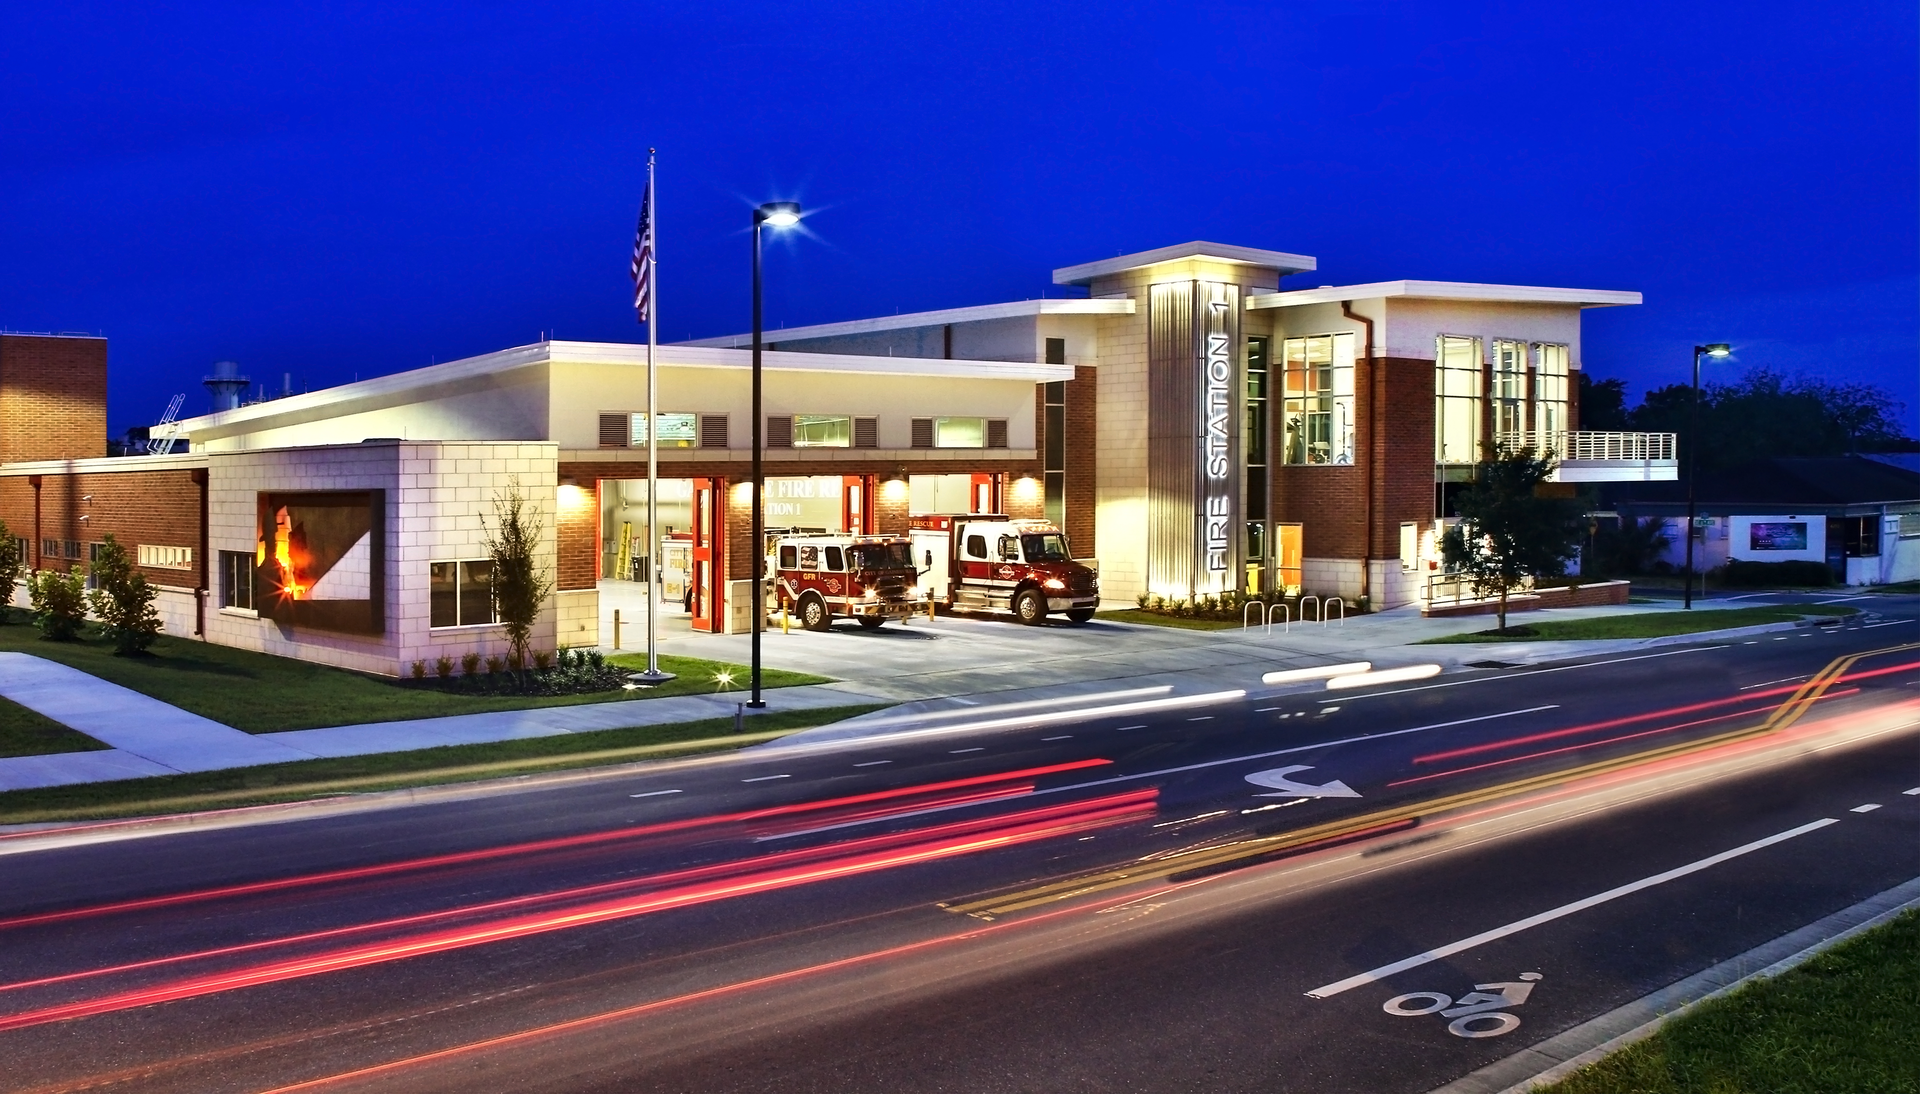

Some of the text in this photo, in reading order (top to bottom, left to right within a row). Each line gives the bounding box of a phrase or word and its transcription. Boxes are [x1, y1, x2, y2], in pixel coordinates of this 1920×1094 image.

[1208, 301, 1230, 573] FIRE STATION 1
[777, 480, 815, 498] FIRE
[796, 503, 802, 516] 1
[913, 520, 934, 528] RESCUE
